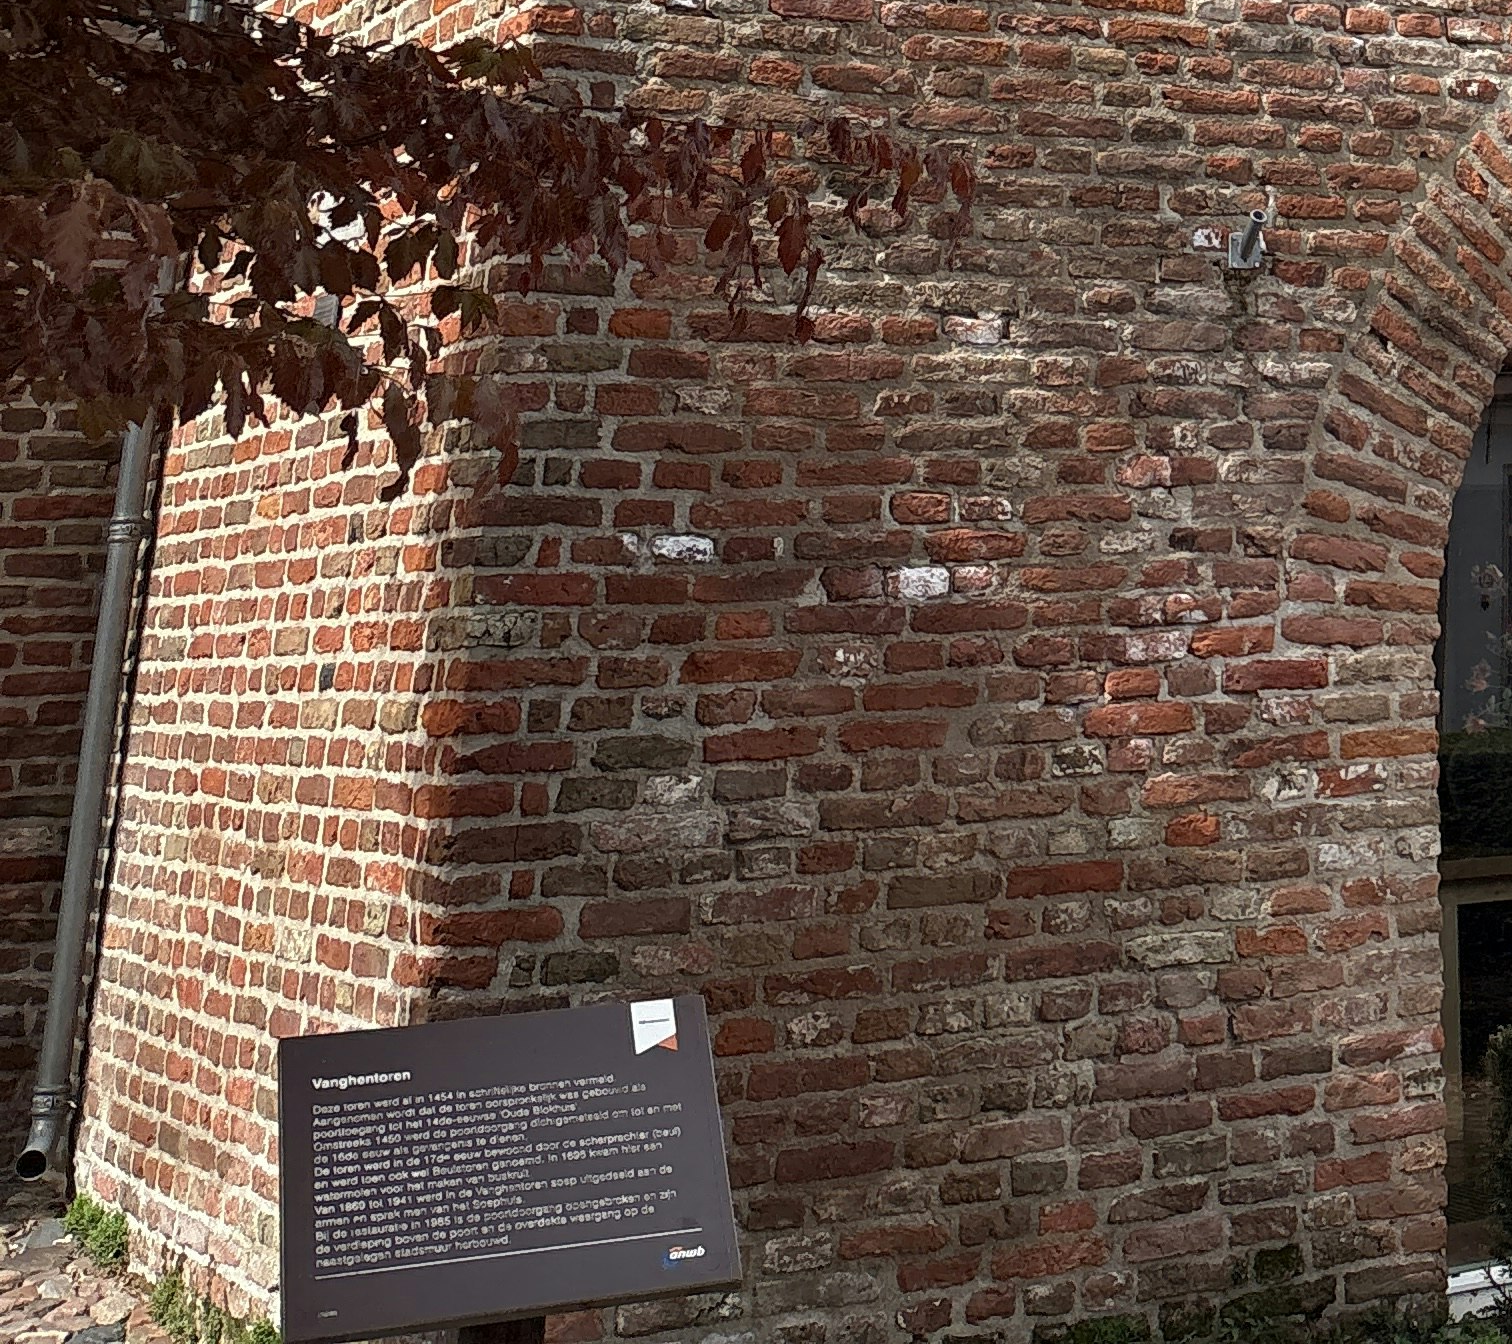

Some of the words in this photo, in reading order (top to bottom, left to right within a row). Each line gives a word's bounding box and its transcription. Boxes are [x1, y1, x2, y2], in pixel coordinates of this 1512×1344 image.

[312, 1071, 410, 1089] Vanghentoren
[474, 1180, 547, 1197] Vanghentoren
[669, 1247, 706, 1261] anwb
